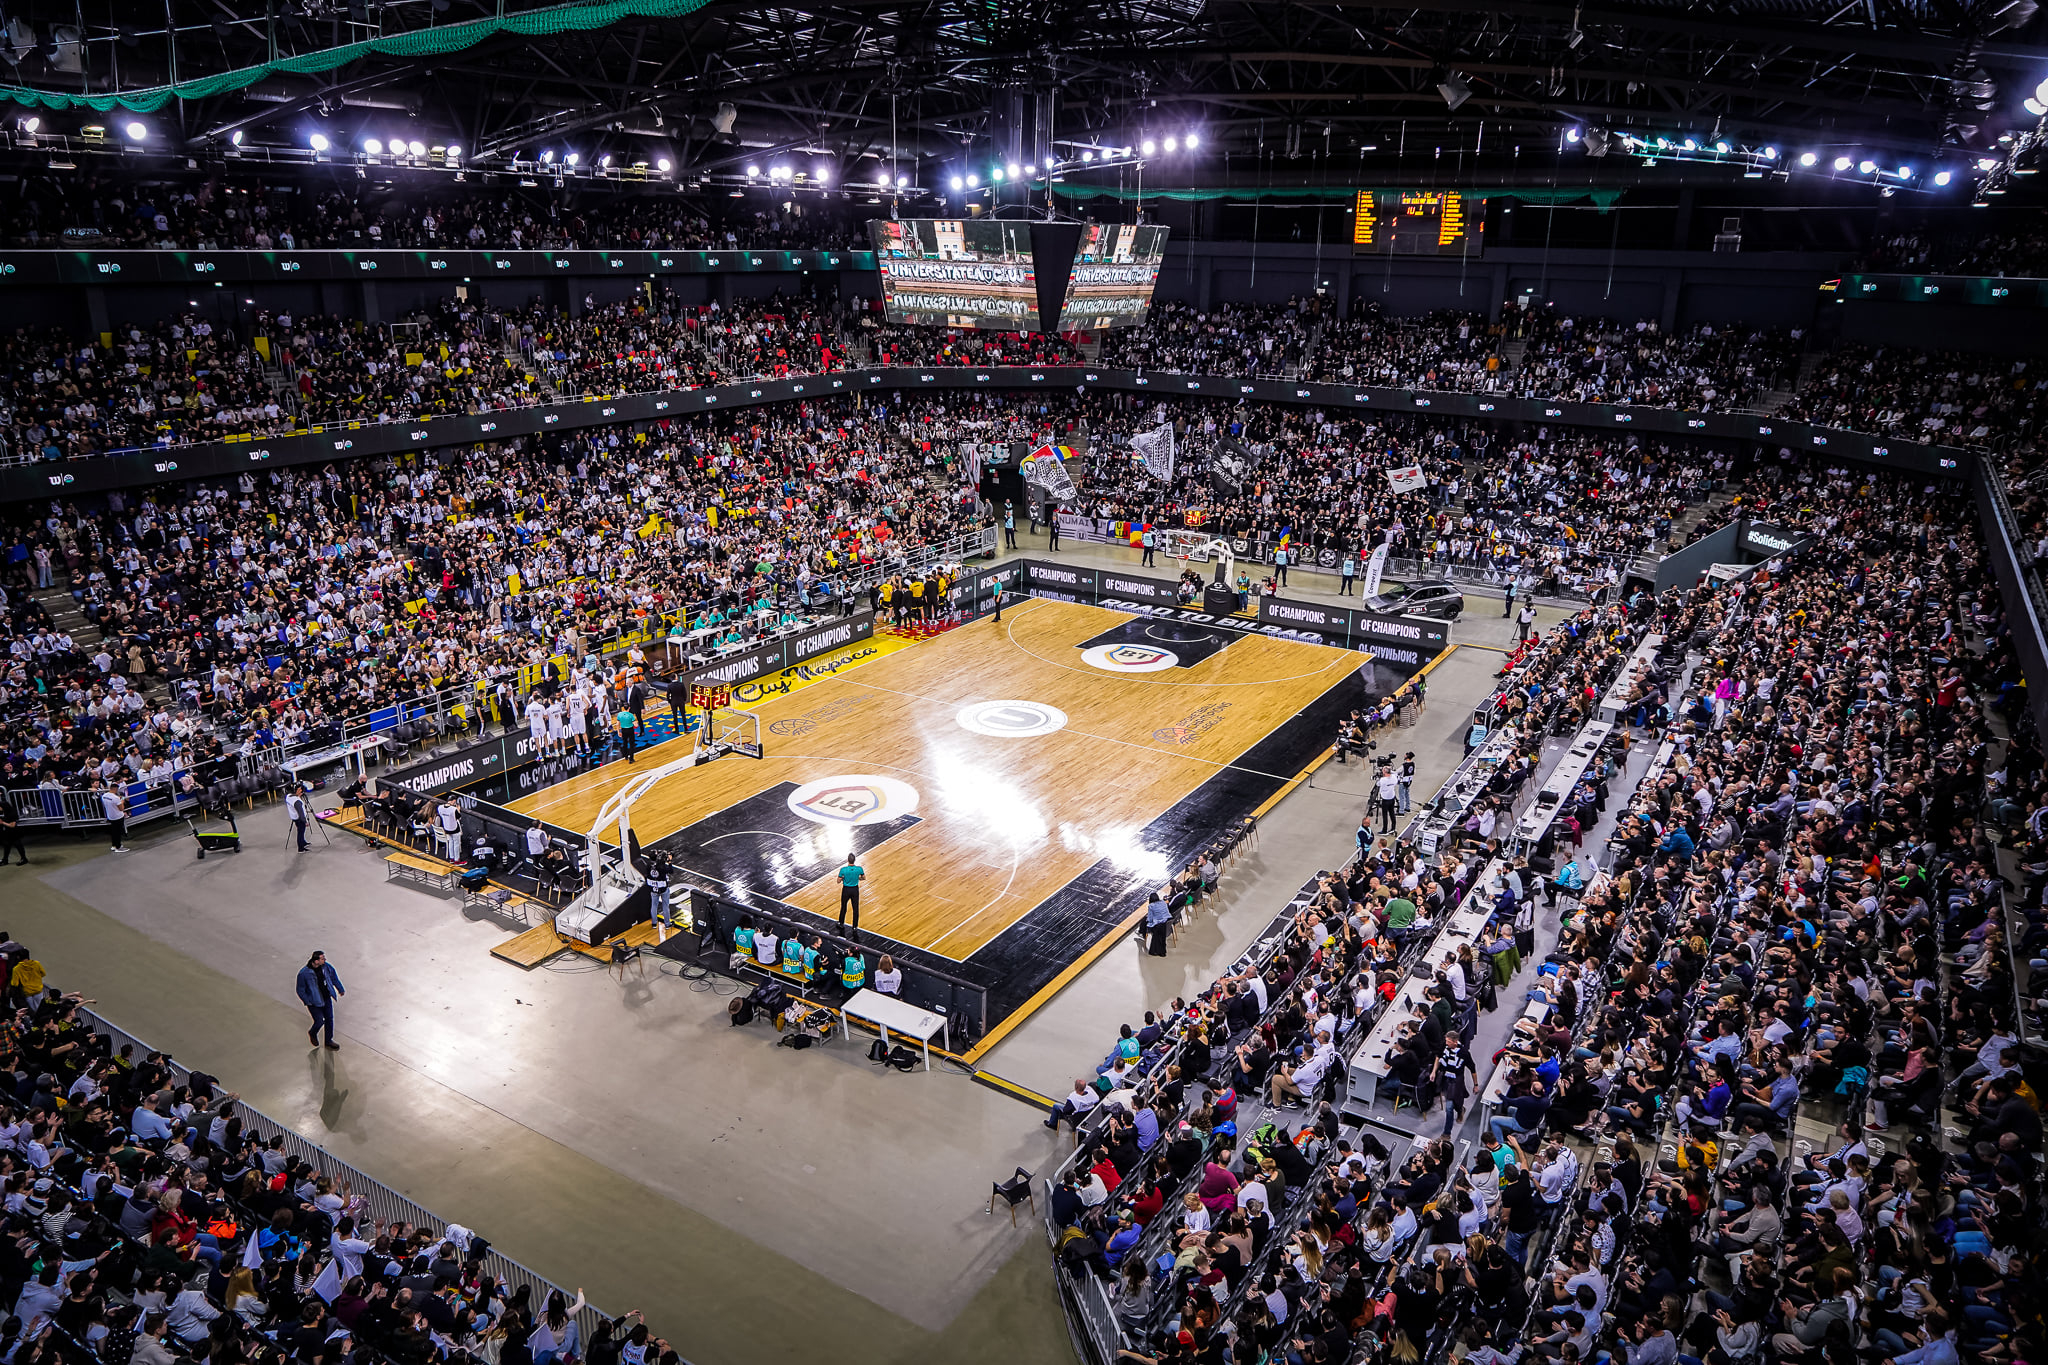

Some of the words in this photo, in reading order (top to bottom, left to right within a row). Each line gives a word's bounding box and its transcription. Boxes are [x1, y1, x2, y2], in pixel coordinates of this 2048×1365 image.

[1059, 515, 1089, 527] NUMAI
[1748, 531, 1793, 550] #Solidarity
[1030, 566, 1039, 578] OF
[1038, 567, 1076, 584] CHAMPIONS
[1106, 579, 1115, 590] OF
[1115, 580, 1155, 597] CHAMPIONS
[1098, 598, 1180, 616] ROAD
[1178, 610, 1215, 623] TO
[1215, 617, 1323, 641] BILBAO
[1269, 605, 1280, 617] OF
[1280, 606, 1325, 625] CHAMPIONS
[1361, 619, 1371, 631] OF
[1371, 620, 1420, 639] CHAMPIONS
[796, 641, 806, 657] OF
[805, 624, 851, 654] CHAMPIONS
[1118, 649, 1154, 661] BT
[573, 701, 580, 709] 14
[983, 708, 1041, 728] U
[516, 739, 529, 756] OF
[412, 758, 474, 792] CHAMPIONS
[819, 797, 867, 814] BT
